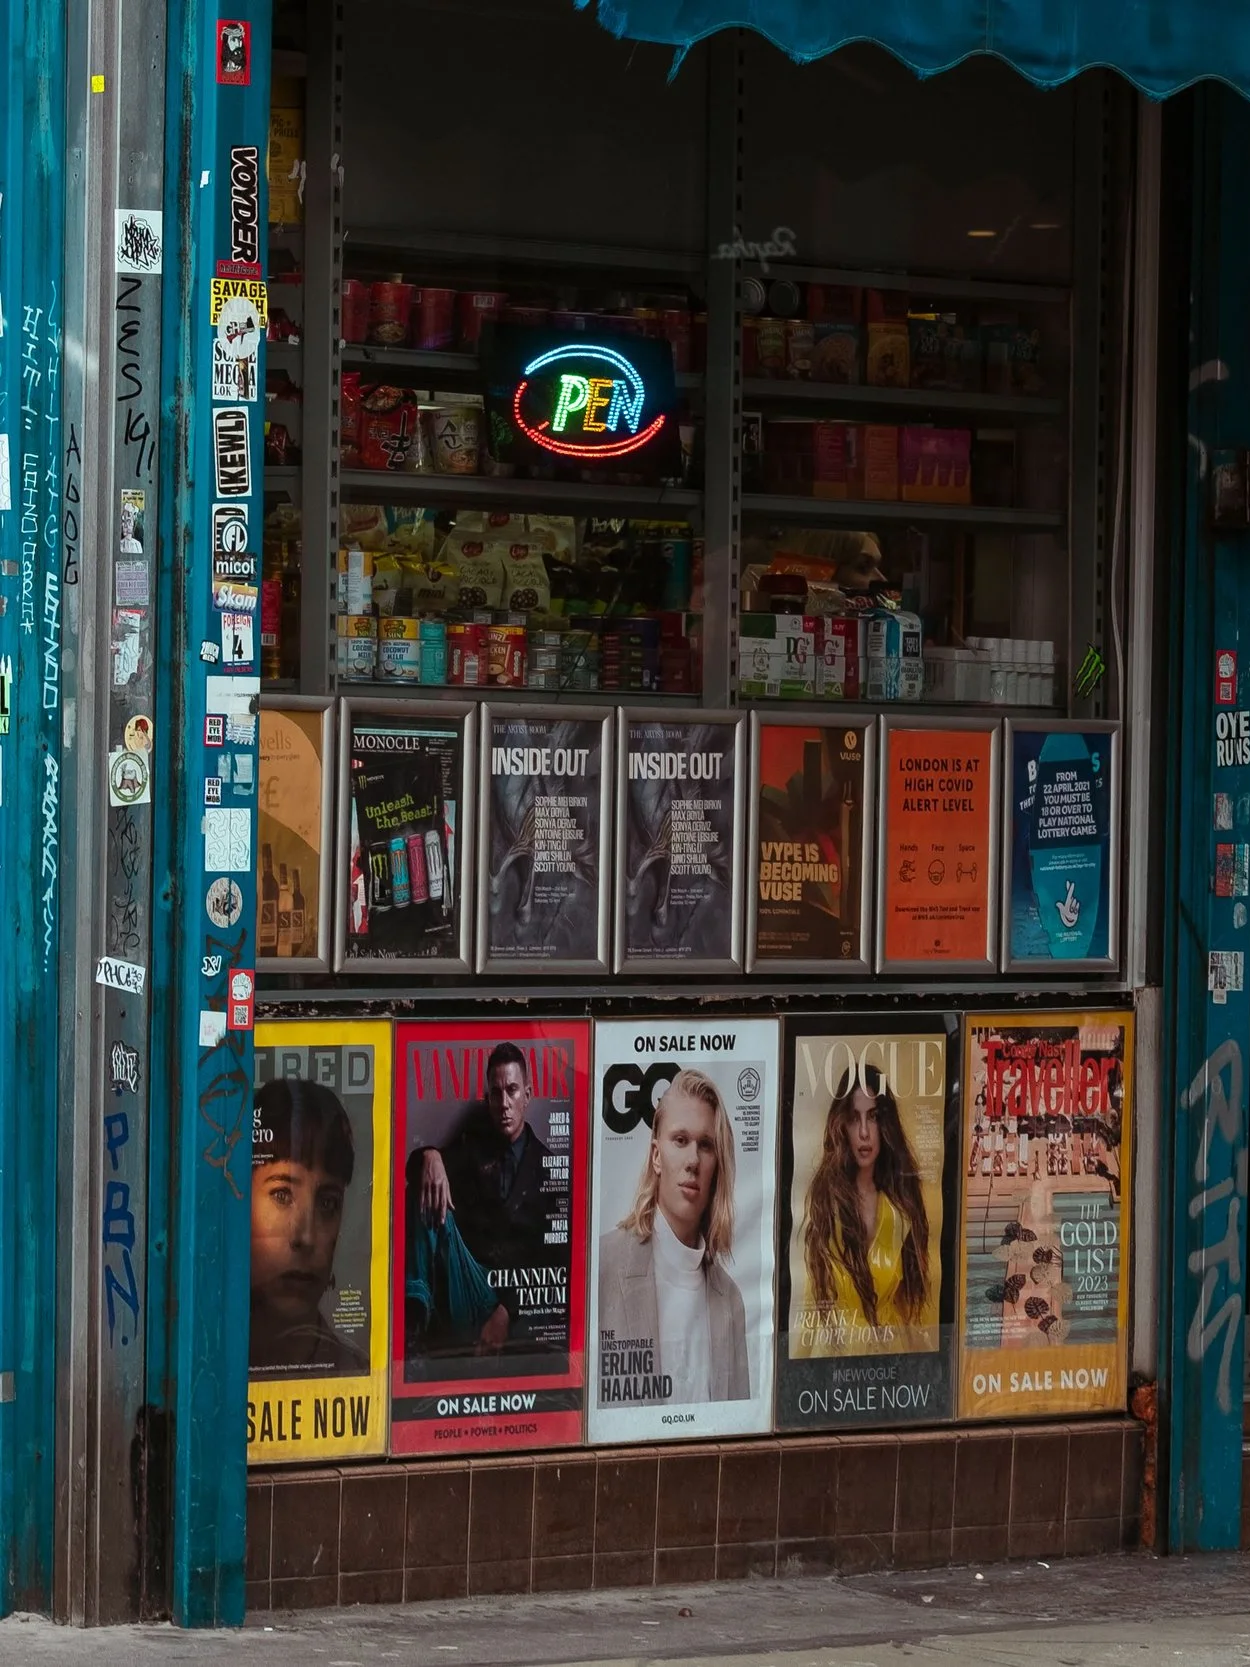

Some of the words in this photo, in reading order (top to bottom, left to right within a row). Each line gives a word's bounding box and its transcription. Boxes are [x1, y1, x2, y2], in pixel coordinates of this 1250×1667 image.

[213, 280, 266, 298] SAVAGE
[515, 375, 645, 434] PEN
[208, 718, 221, 727] RED
[1216, 711, 1250, 738] OYE
[207, 735, 222, 743] MOB
[209, 727, 221, 735] EYE
[353, 735, 420, 750] MONOCLE
[1216, 737, 1250, 767] RUNS
[492, 747, 551, 776] INSIDE
[554, 748, 589, 777] OUT
[628, 752, 687, 780] INSIDE
[689, 753, 723, 781] OUT
[900, 758, 948, 772] LONDON
[952, 759, 961, 772] IS
[965, 759, 980, 772] AT
[207, 779, 220, 787] RED
[1055, 771, 1078, 782] FROM
[207, 787, 220, 795] EYE
[904, 779, 934, 791] HIGH
[938, 779, 974, 792] COVID
[1043, 783, 1052, 794] 22
[1052, 782, 1074, 793] APRIL
[1074, 781, 1091, 791] 2021
[206, 794, 221, 803] MOB
[365, 793, 414, 819] Unleash
[903, 798, 939, 812] ALERT
[942, 799, 974, 812] LEVEL
[1044, 794, 1059, 805] YOU
[1059, 793, 1081, 804] MUST
[1081, 792, 1091, 802] BE
[535, 807, 550, 818] MAX
[1041, 806, 1050, 816] 18
[1050, 805, 1061, 816] OR
[1061, 804, 1082, 815] OVER
[1082, 802, 1092, 813] TO
[376, 814, 400, 829] the
[1039, 816, 1058, 828] PLAY
[1058, 814, 1095, 826] NATIONAL
[1037, 828, 1070, 839] LOTTERY
[1070, 825, 1097, 836] GAMES
[761, 841, 802, 862] VYPE
[805, 843, 819, 862] IS
[534, 861, 555, 872] SCOTT
[556, 862, 576, 873] YOUNG
[760, 862, 840, 883] BECOMING
[760, 882, 802, 901] VUSE
[634, 1036, 656, 1053] ON
[658, 1035, 696, 1052] SALE
[699, 1034, 737, 1051] NOW
[254, 1046, 372, 1095] IRED
[412, 1047, 489, 1101] VANIT
[524, 1044, 571, 1098] AIR
[801, 1040, 943, 1099] VOGUE
[981, 1039, 1118, 1117] Traveller
[549, 1112, 565, 1124] JARED
[542, 1156, 570, 1167] ELIZABETH
[550, 1168, 570, 1180] TAYLOR
[551, 1219, 568, 1231] MAFIA
[543, 1232, 568, 1244] MURDERS
[1060, 1220, 1118, 1248] GOLD
[1074, 1248, 1118, 1275] LIST
[487, 1266, 567, 1288] CHANNING
[1077, 1275, 1109, 1293] 2023
[516, 1286, 567, 1306] TATUM
[601, 1330, 615, 1340] THE
[601, 1338, 654, 1350] UNSTOPPABLE
[600, 1351, 654, 1377] ERLING
[832, 1366, 897, 1382] #NEWVOGUE
[972, 1373, 1002, 1396] ON
[1009, 1370, 1053, 1393] SALE
[1060, 1367, 1109, 1391] NOW
[600, 1374, 673, 1403] HAALAND
[437, 1399, 459, 1416] ON
[464, 1396, 497, 1414] SALE
[501, 1393, 537, 1411] NOW
[799, 1389, 828, 1414] ON
[833, 1386, 877, 1413] SALE
[881, 1384, 930, 1409] NOW
[247, 1400, 301, 1443] SALE
[314, 1396, 370, 1439] NOW
[661, 1413, 696, 1424] GQ.CO.UK
[434, 1425, 462, 1439] PEOPLE
[470, 1425, 497, 1438] POWER
[504, 1423, 537, 1435] POLITICS
